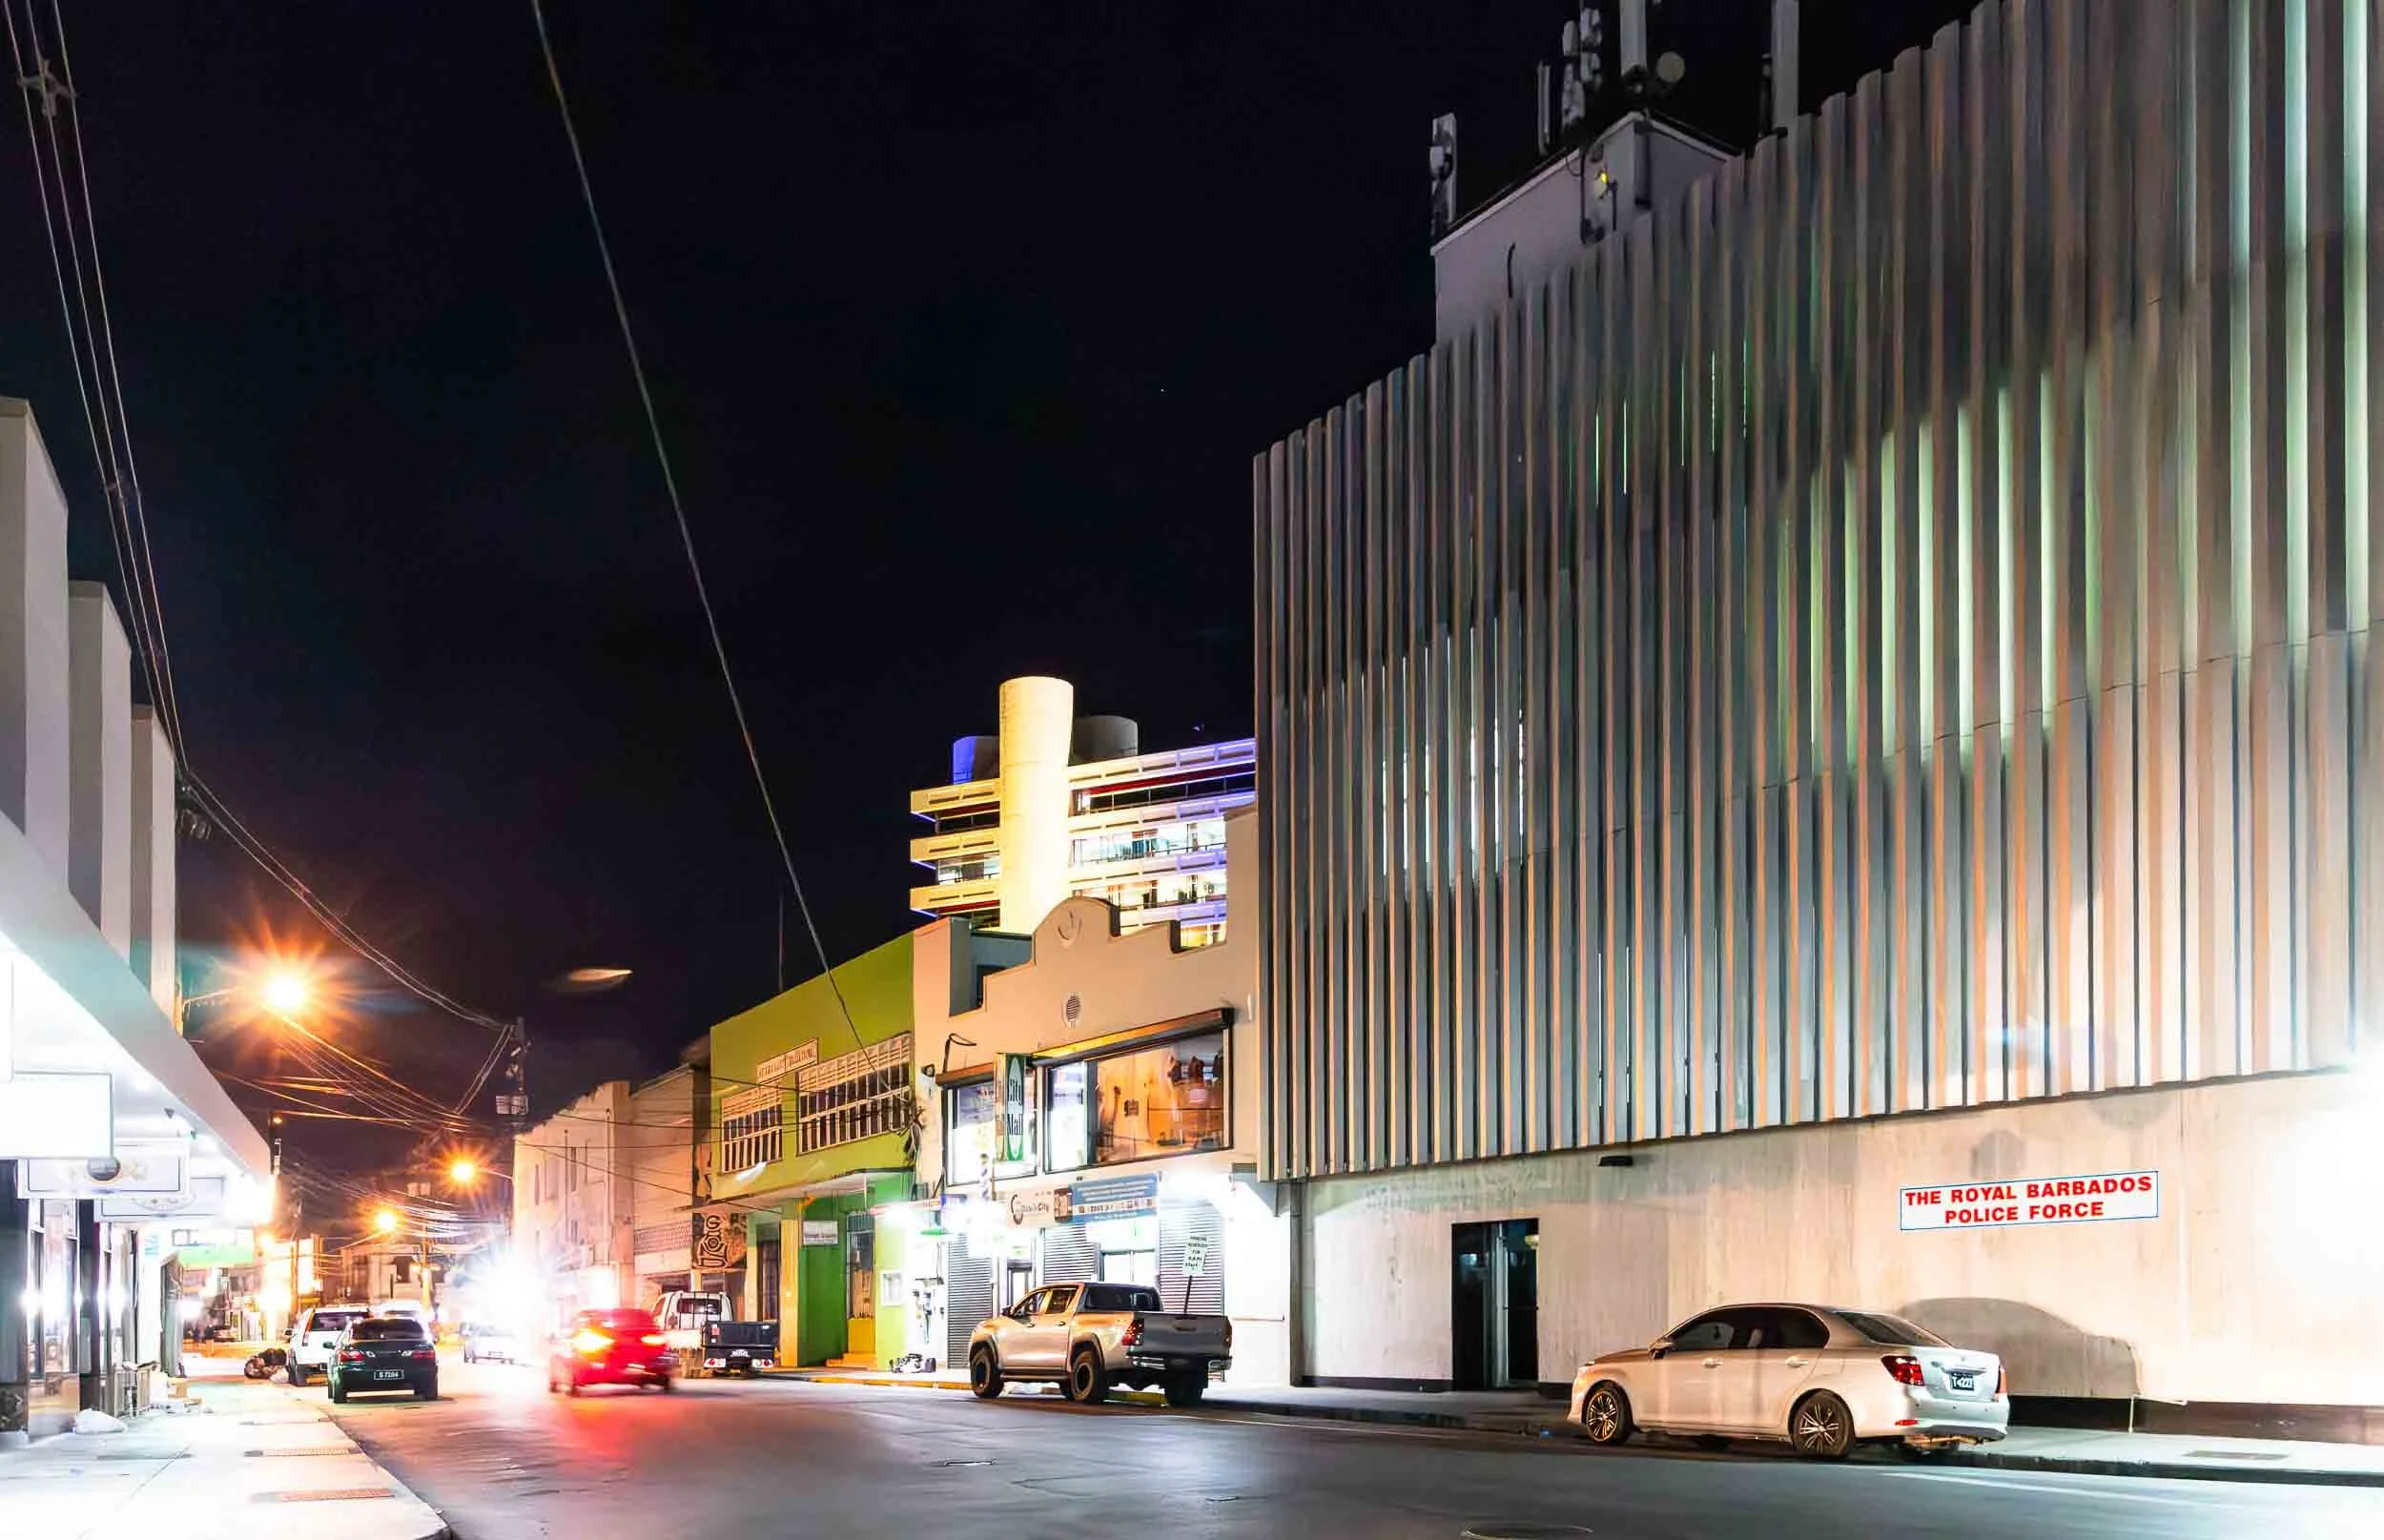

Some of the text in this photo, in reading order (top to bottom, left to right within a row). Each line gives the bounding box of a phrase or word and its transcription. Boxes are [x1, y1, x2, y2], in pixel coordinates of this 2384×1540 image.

[1009, 1078, 1022, 1107] City
[1007, 1113, 1022, 1136] Mall
[1905, 1176, 2153, 1206] THE ROYAL BARBADOS
[1944, 1201, 2105, 1224] POLICE FORCE
